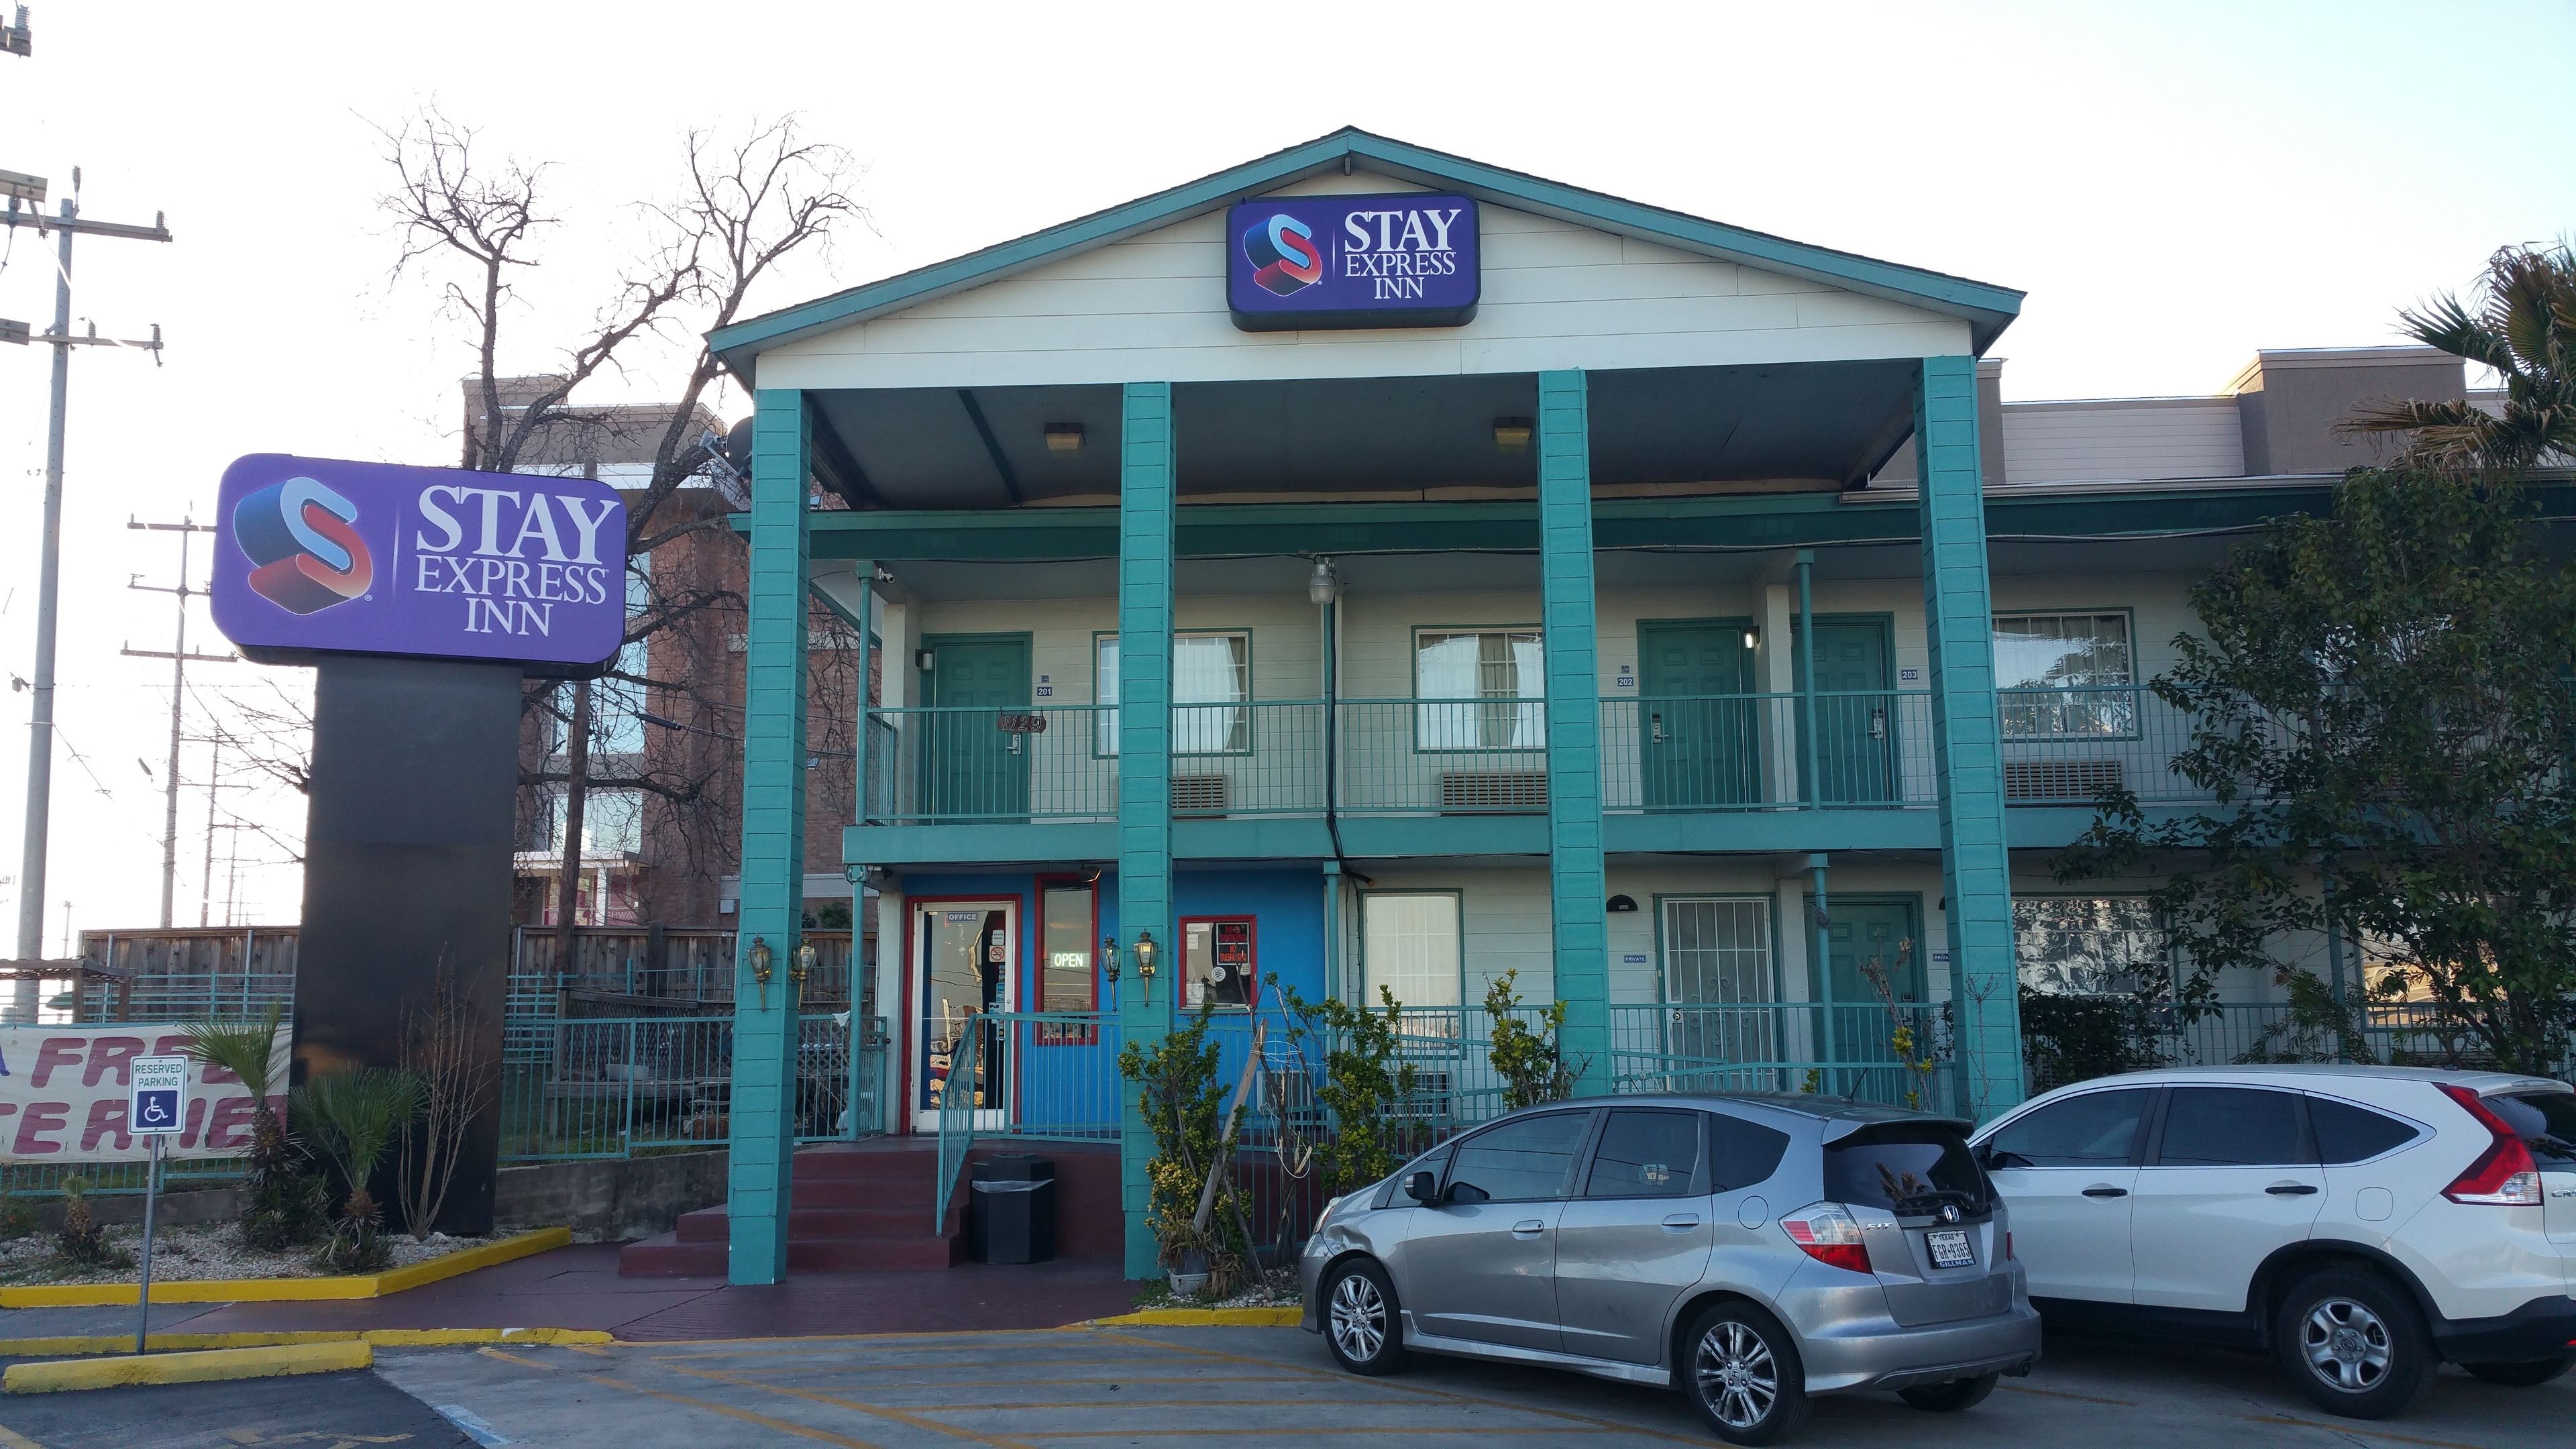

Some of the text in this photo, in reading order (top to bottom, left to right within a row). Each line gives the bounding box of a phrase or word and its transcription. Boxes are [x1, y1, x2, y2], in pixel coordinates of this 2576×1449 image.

[1344, 209, 1462, 252] STAY
[1344, 252, 1456, 277] EXPRESS
[1374, 276, 1425, 299] INN
[416, 484, 621, 565] STAY
[414, 554, 607, 604] EXPRESS
[464, 597, 553, 637] INN
[1002, 715, 1042, 733] 1129
[1054, 953, 1083, 967] OPEN
[135, 1064, 182, 1074] RESERVED
[138, 1077, 178, 1087] PARKING
[1866, 1222, 1892, 1230] FIT
[1939, 1259, 1974, 1267] GILLMAN
